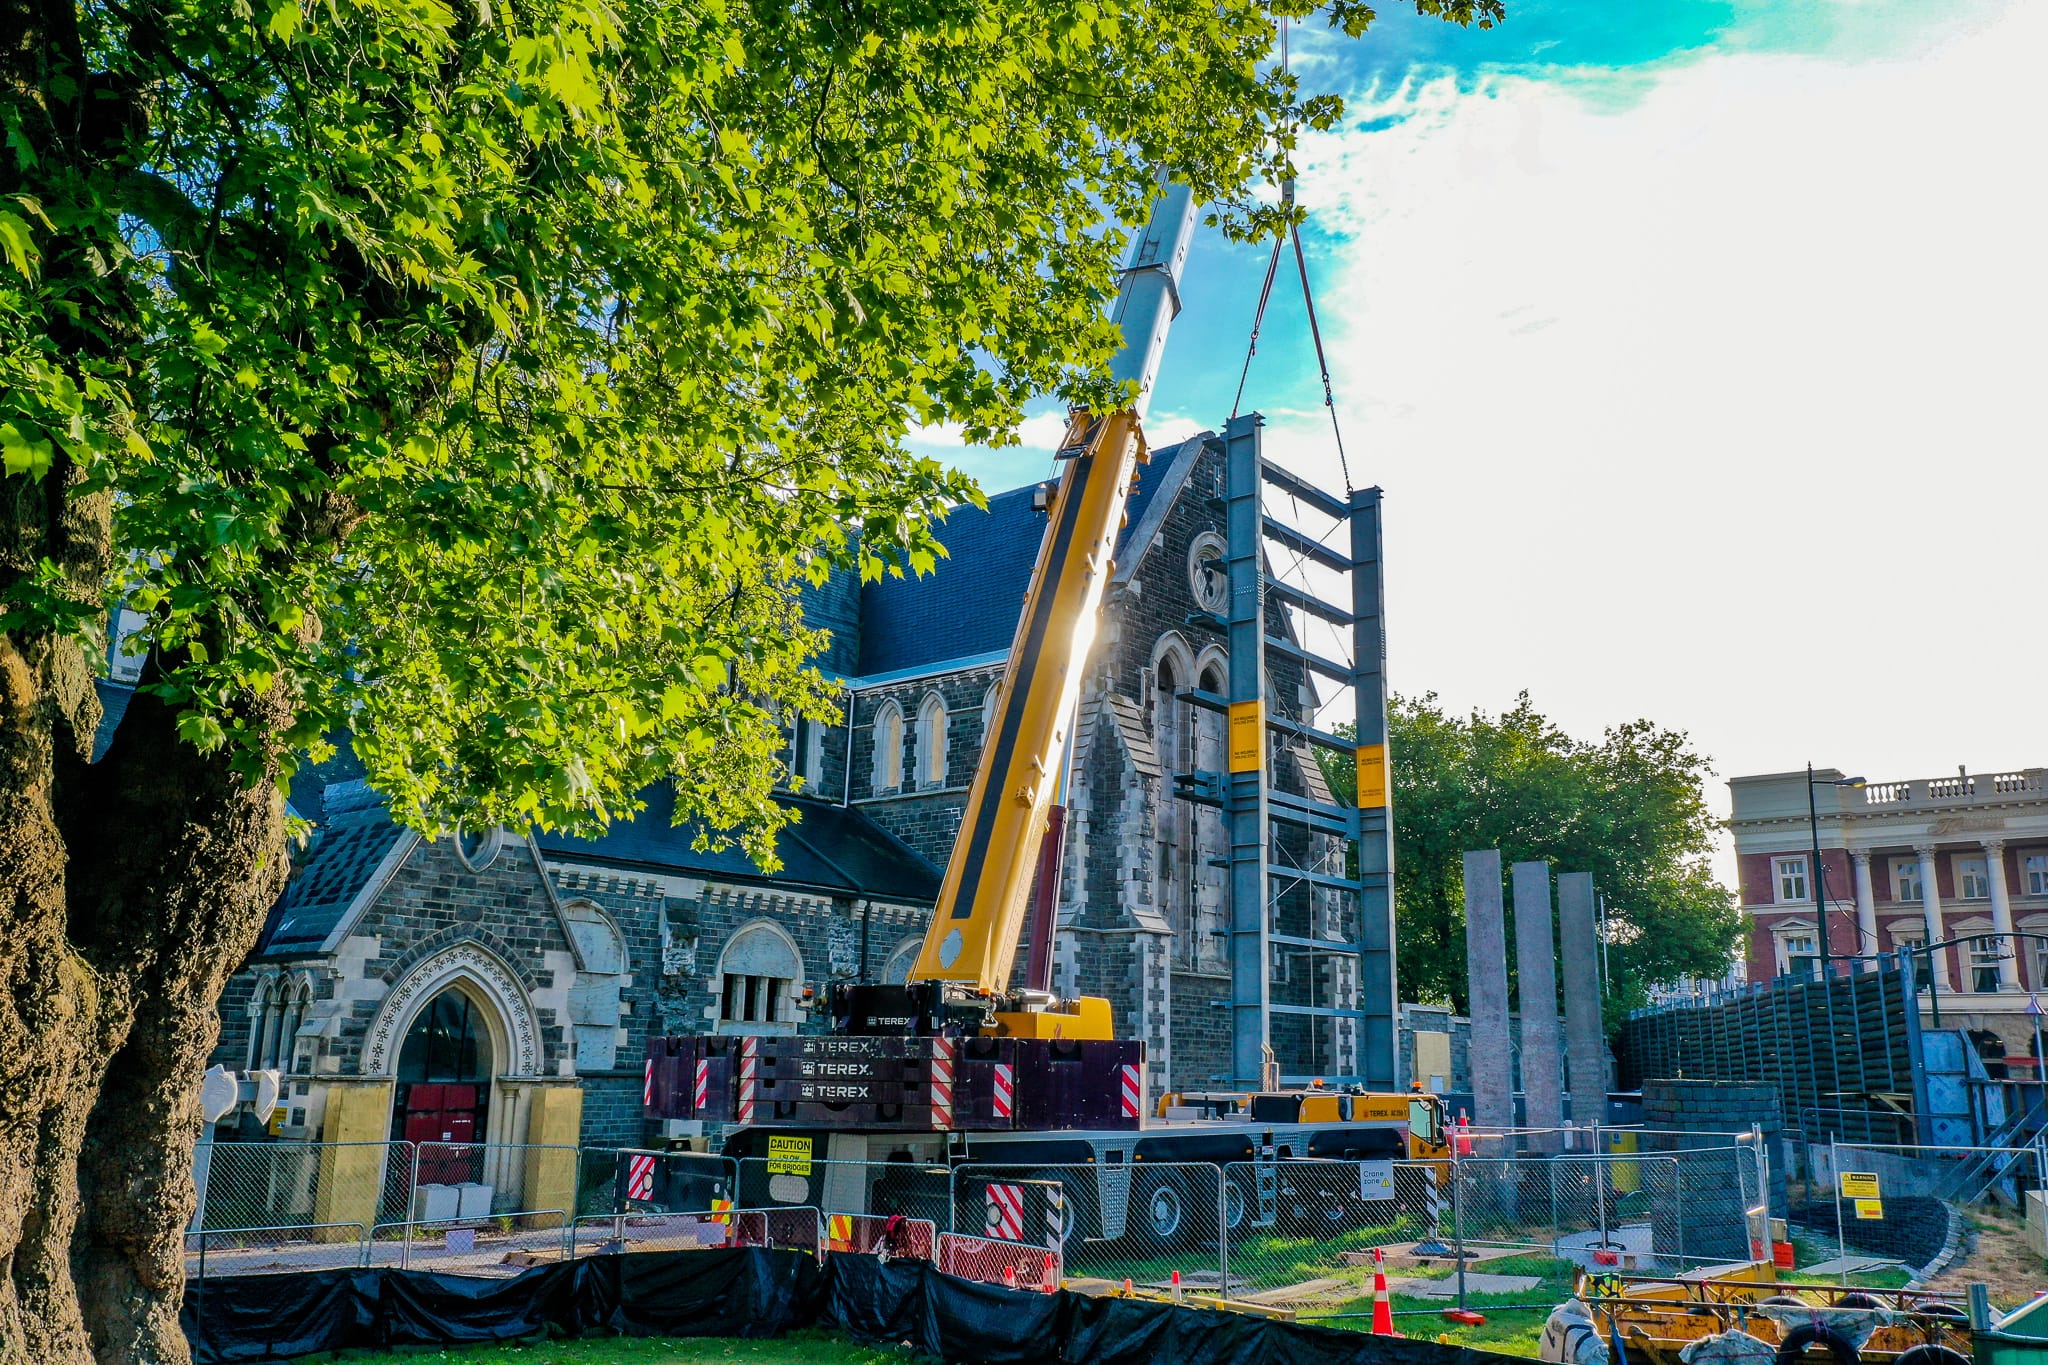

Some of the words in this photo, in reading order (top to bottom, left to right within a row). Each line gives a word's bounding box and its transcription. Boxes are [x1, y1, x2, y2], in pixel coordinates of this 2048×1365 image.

[878, 1017, 911, 1025] TEREX
[819, 1042, 870, 1052] TEREX
[818, 1064, 870, 1075] TEREX
[817, 1086, 869, 1097] TEREX
[770, 1139, 811, 1150] CAUTION
[782, 1163, 810, 1171] BRIDGES
[1363, 1170, 1384, 1178] Crane
